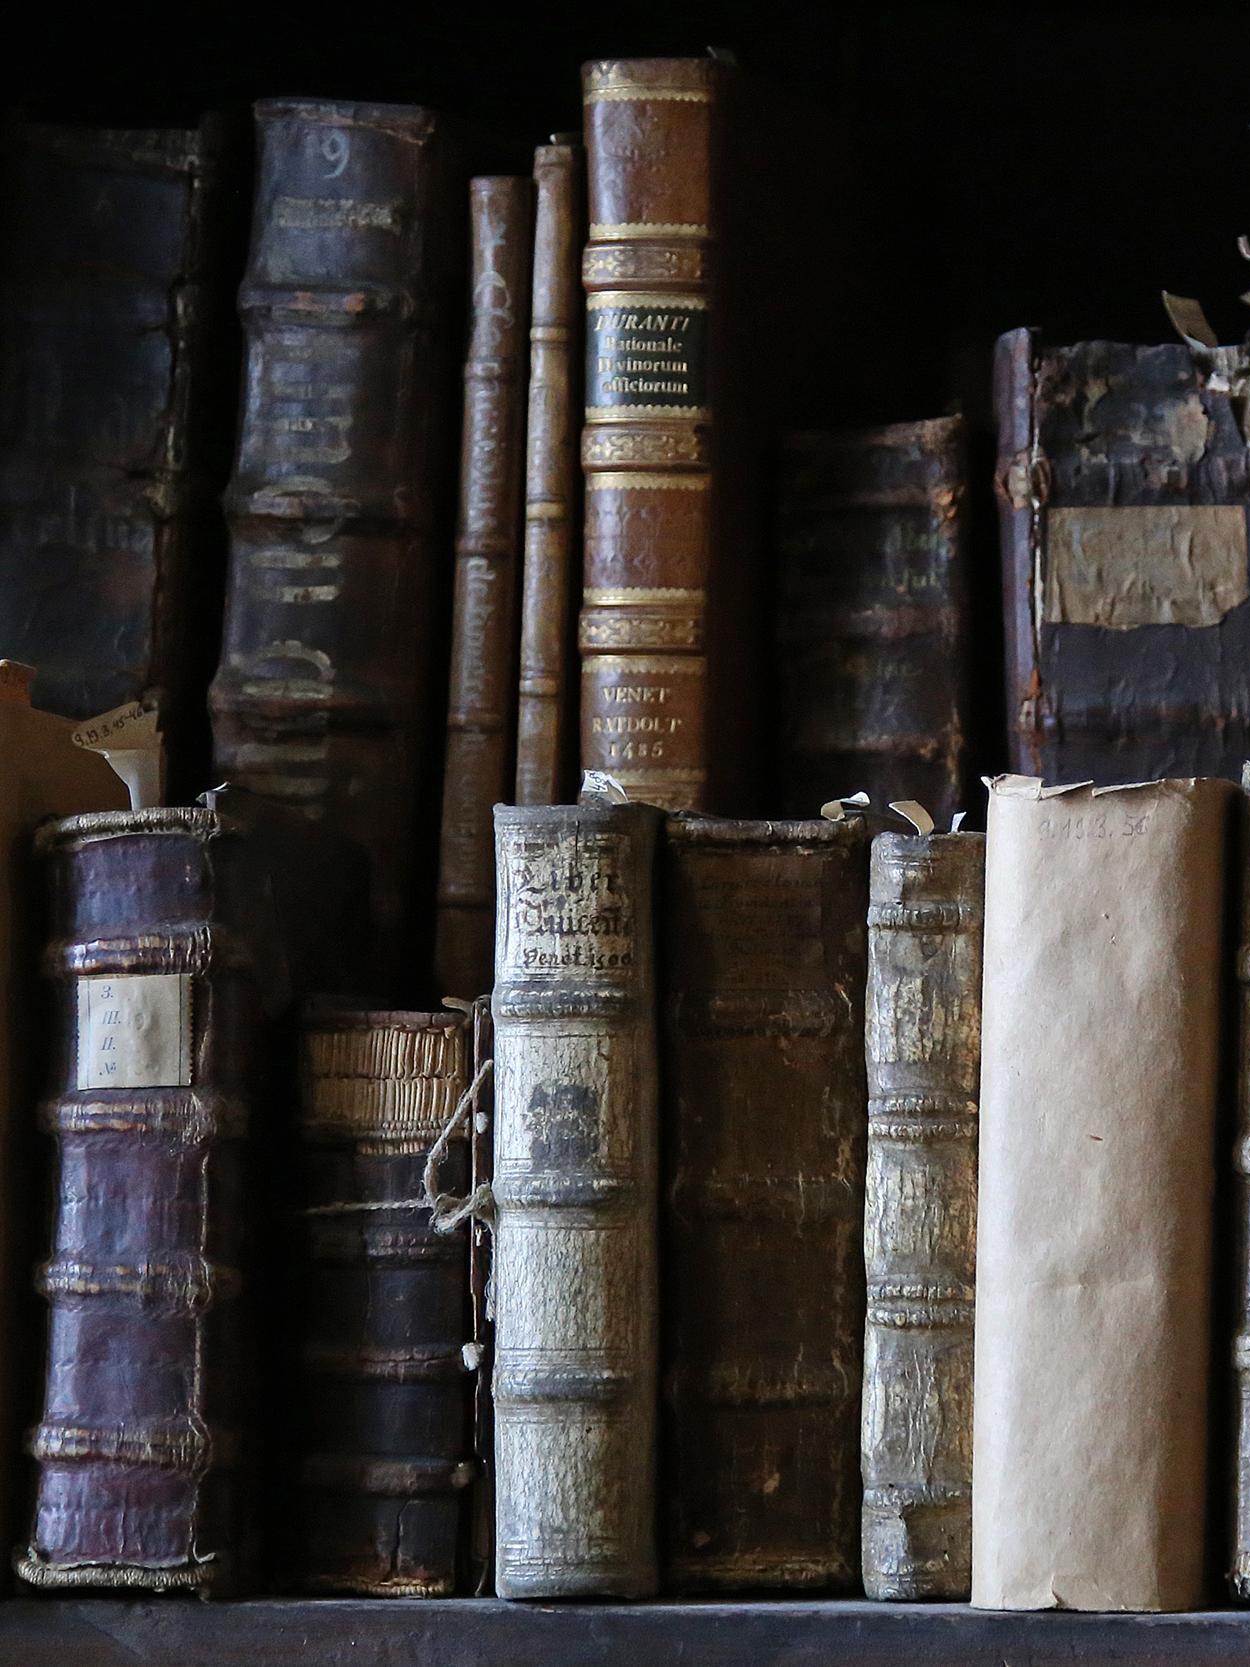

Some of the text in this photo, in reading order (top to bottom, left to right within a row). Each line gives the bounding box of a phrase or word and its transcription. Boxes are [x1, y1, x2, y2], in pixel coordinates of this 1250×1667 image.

[320, 130, 350, 180] 9
[594, 313, 690, 332] DURANTI
[604, 336, 683, 353] Rationale
[602, 686, 672, 704] VENET
